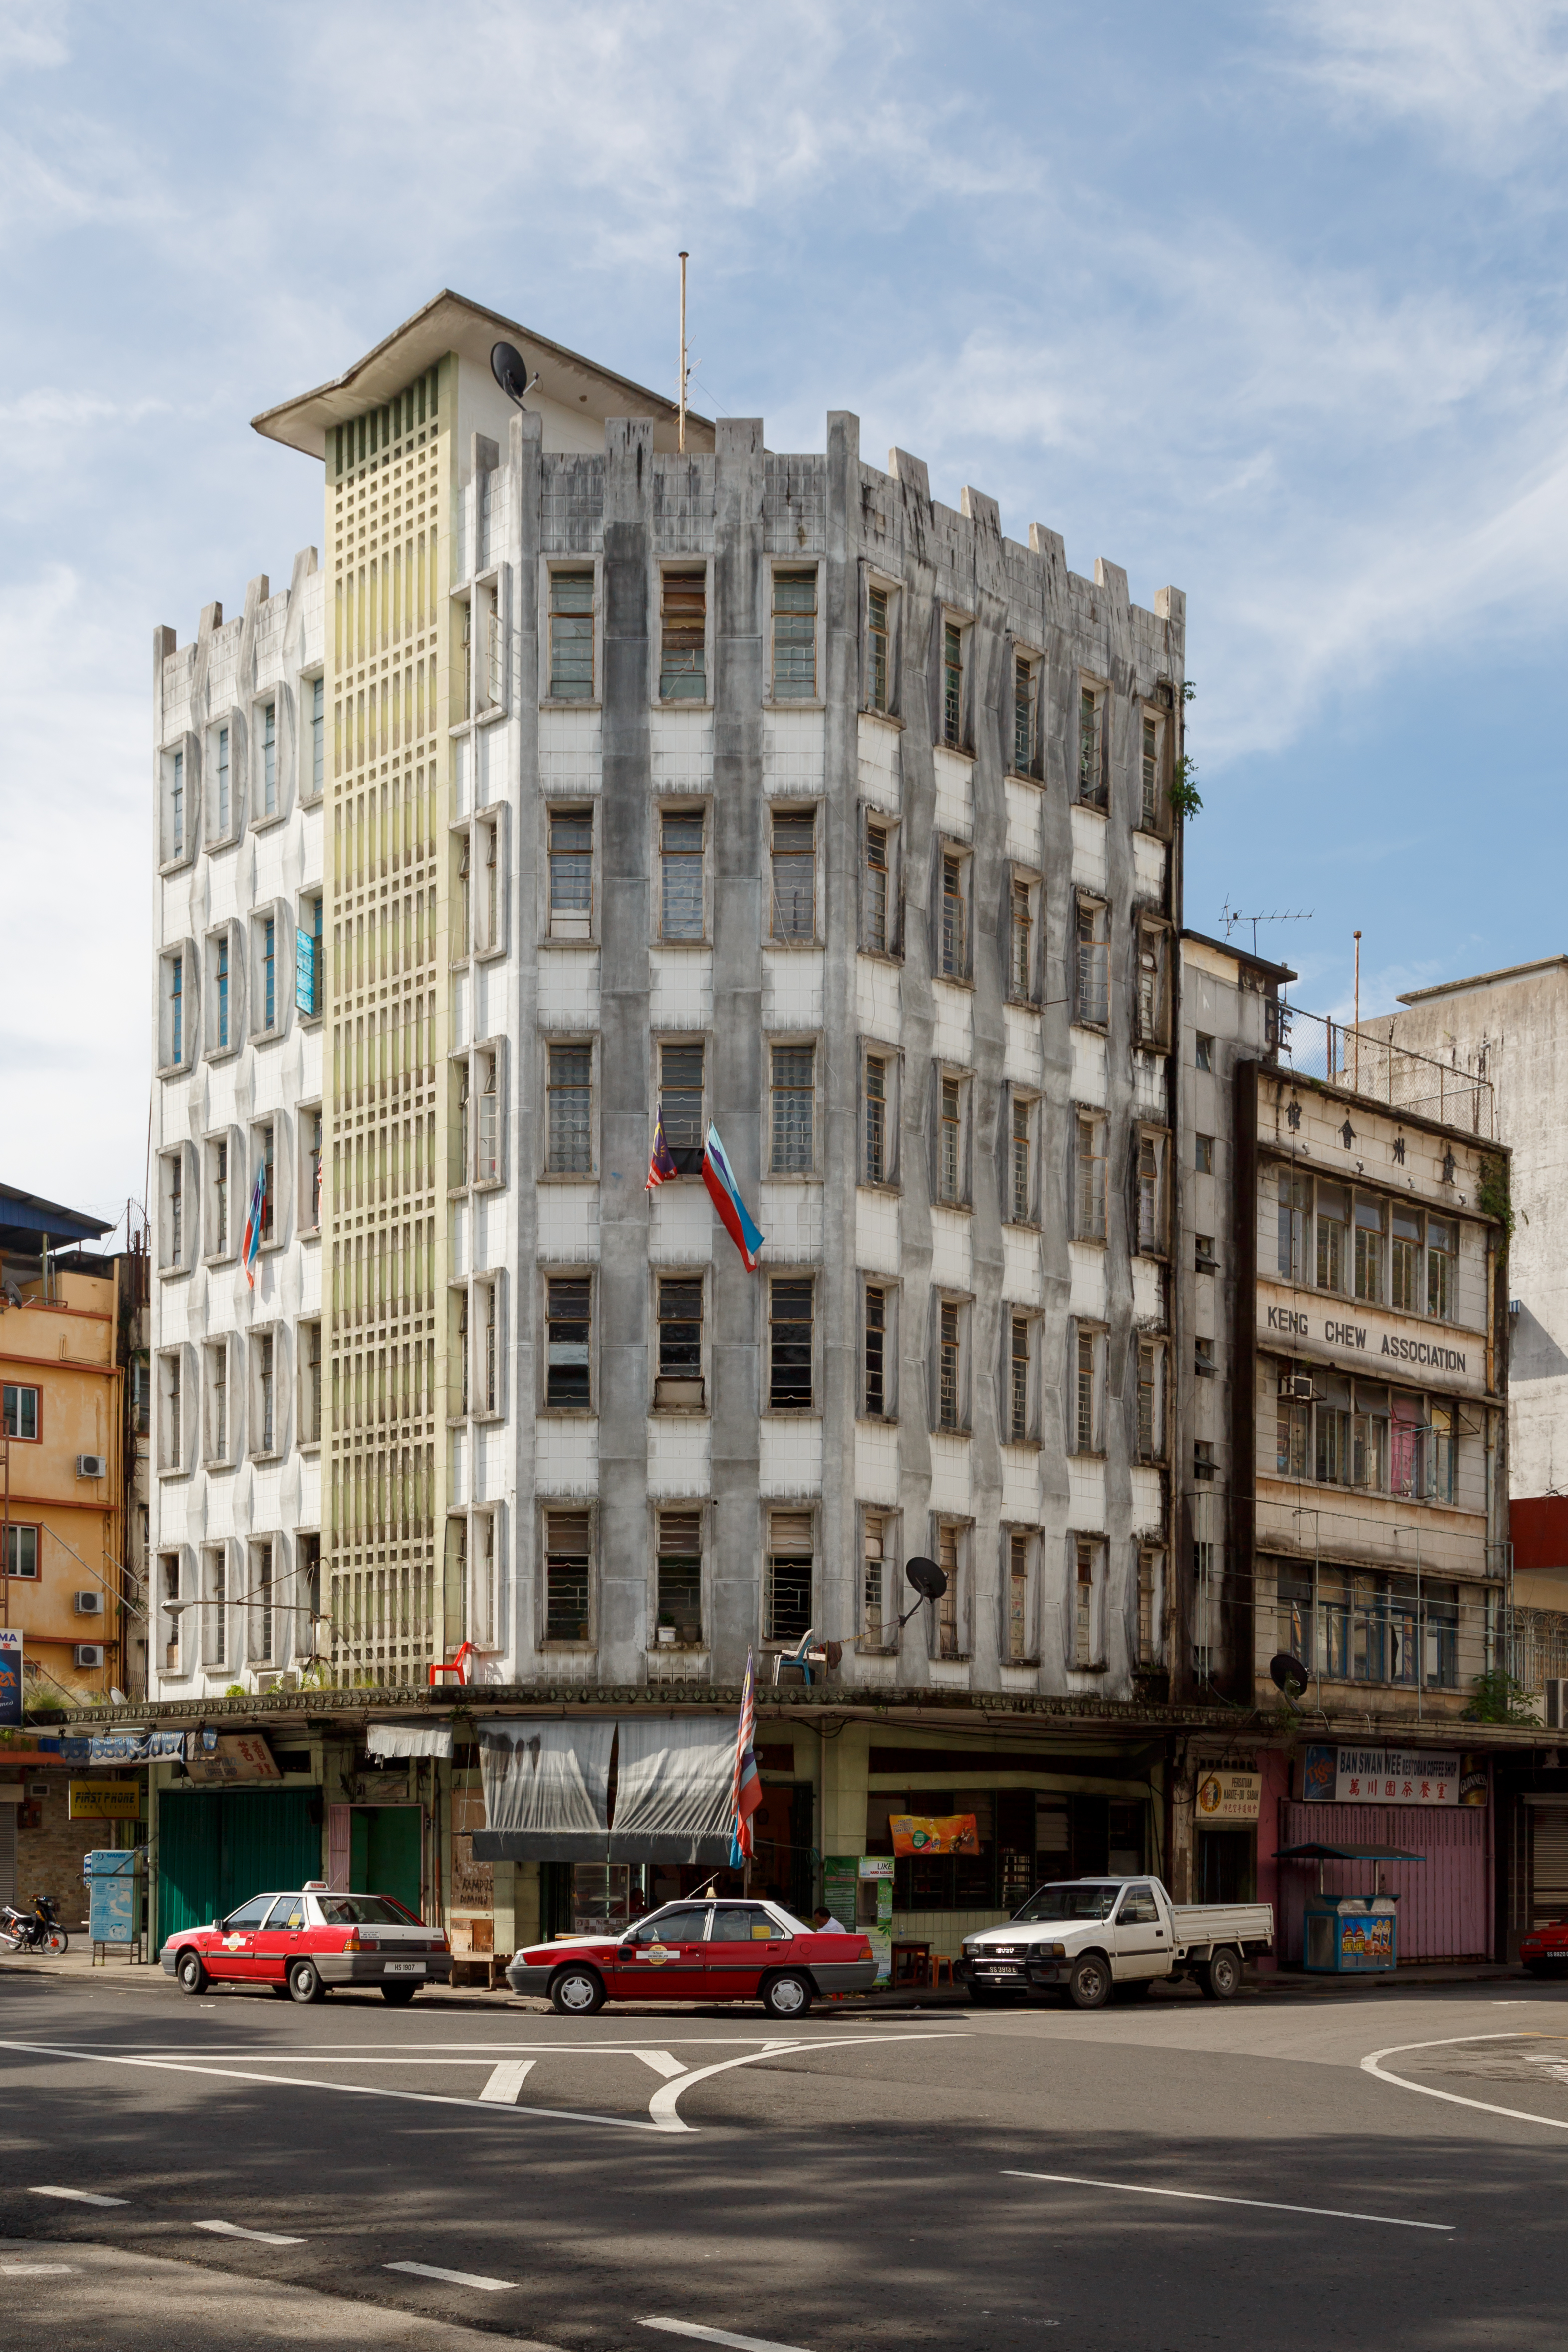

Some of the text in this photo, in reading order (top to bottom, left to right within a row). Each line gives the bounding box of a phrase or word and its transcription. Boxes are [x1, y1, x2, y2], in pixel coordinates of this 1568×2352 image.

[1268, 1306, 1466, 1373] KENG CHEW ASSOCIATION
[1340, 1751, 1457, 1778] BAN SWAN WEE RESTORAN COFFEE SHOP
[205, 1768, 223, 1777] COFFEE
[1232, 1777, 1252, 1788] PERSATUAN
[1460, 1773, 1487, 1794] GUINNESS
[75, 1792, 135, 1803] FIRST PHONE
[1247, 1790, 1259, 1800] SABAH
